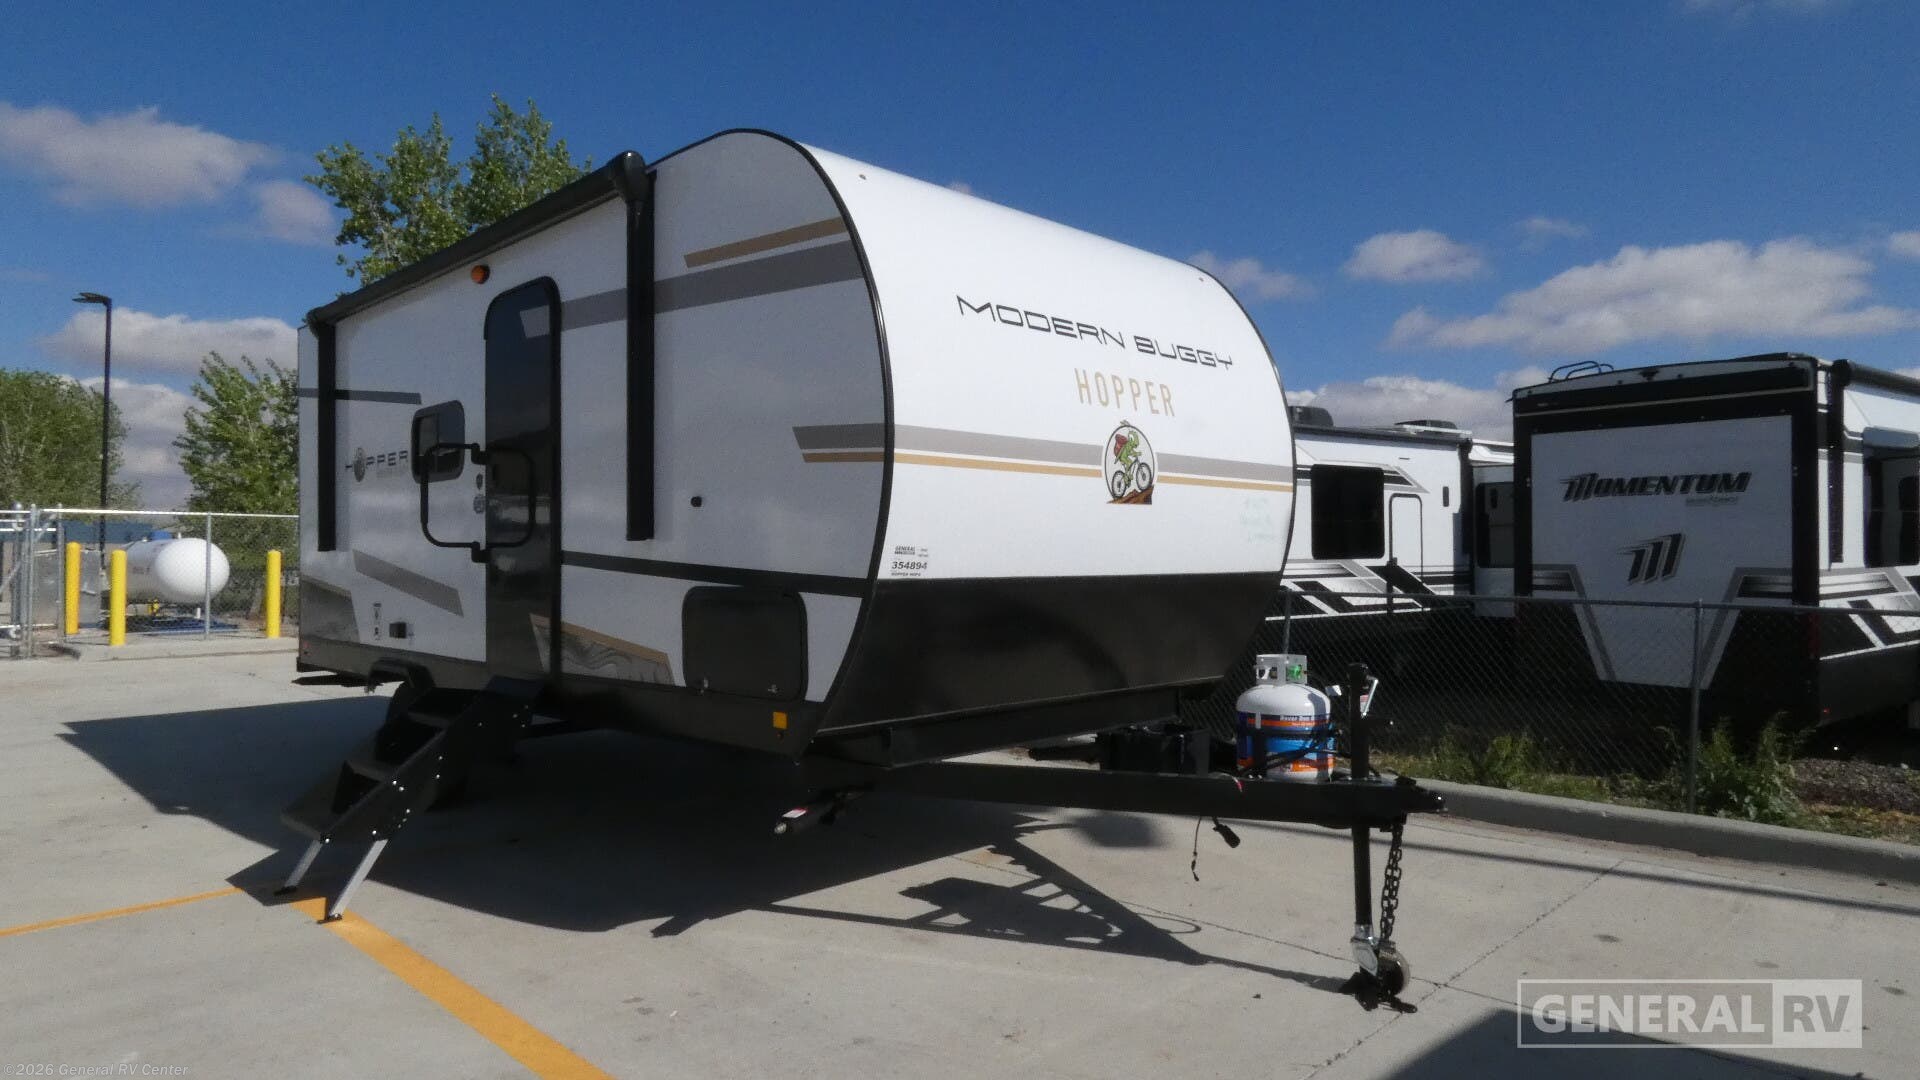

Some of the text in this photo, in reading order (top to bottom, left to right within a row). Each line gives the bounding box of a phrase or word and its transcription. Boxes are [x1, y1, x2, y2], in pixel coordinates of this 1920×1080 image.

[956, 294, 1233, 370] MODERN BUGGY
[1074, 367, 1175, 417] HOPPER
[1561, 472, 1753, 502] MOMENTUM
[891, 561, 928, 570] 354894
